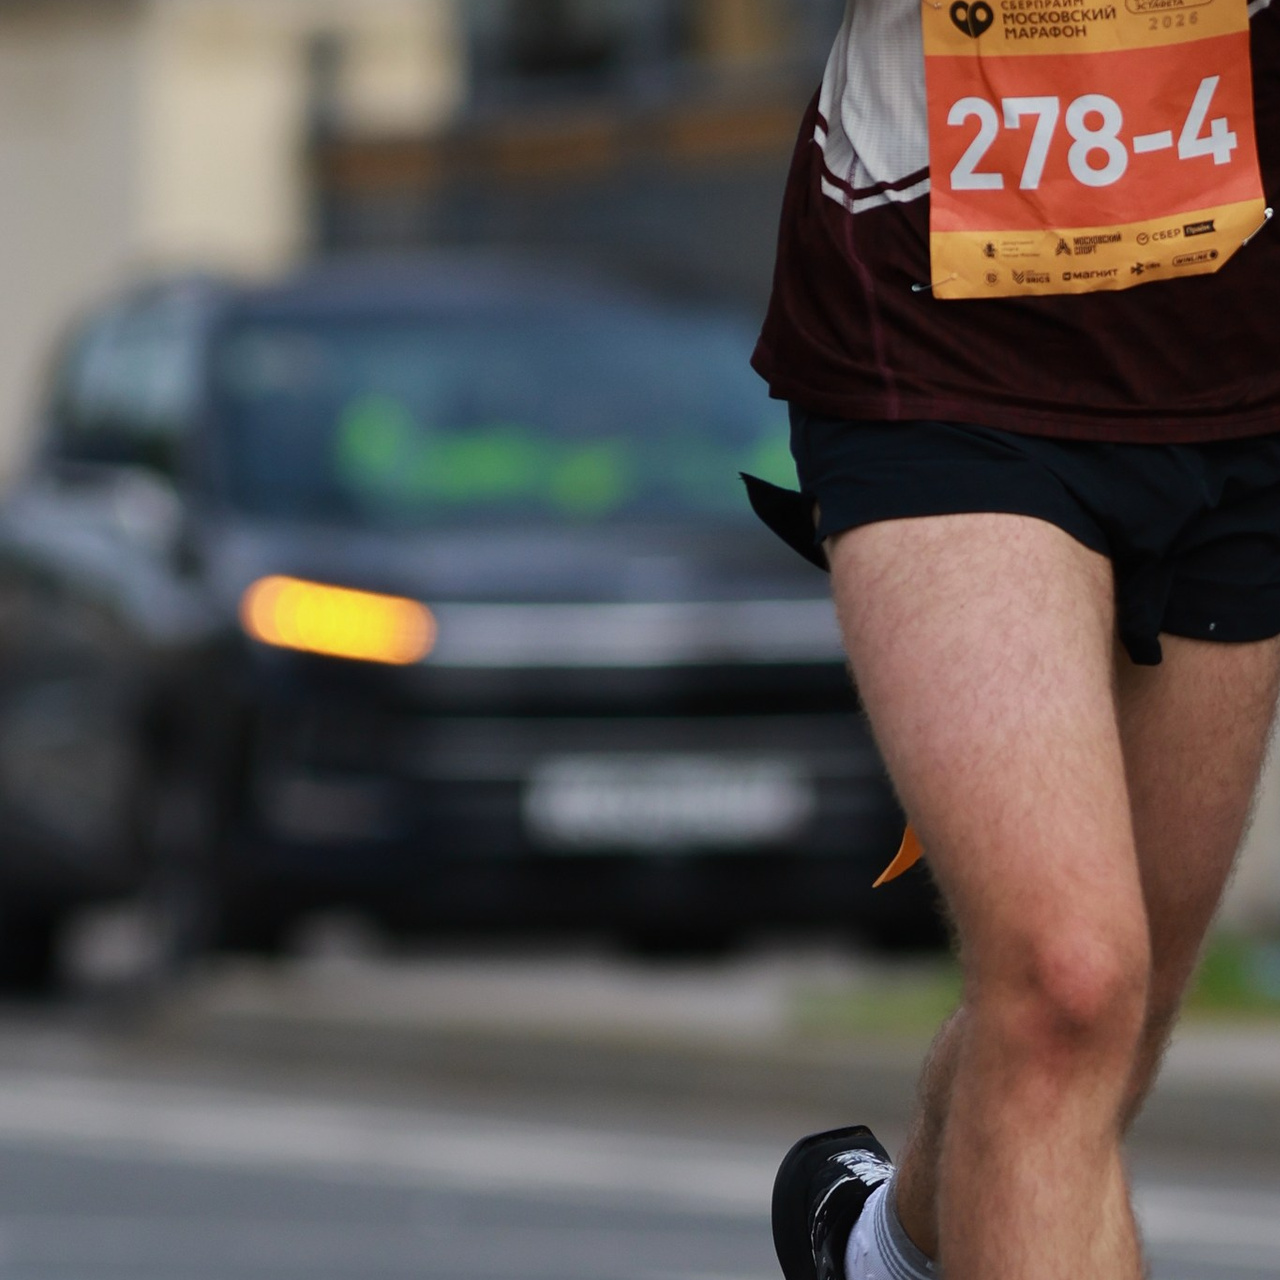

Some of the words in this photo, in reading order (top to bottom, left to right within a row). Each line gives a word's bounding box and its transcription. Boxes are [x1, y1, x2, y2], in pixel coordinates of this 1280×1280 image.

[1002, 4, 1117, 25] МОСКОВСКИЙ
[1004, 24, 1087, 40] МАРАФОН
[946, 74, 1238, 191] 278-4
[1151, 228, 1181, 241] СБЕР
